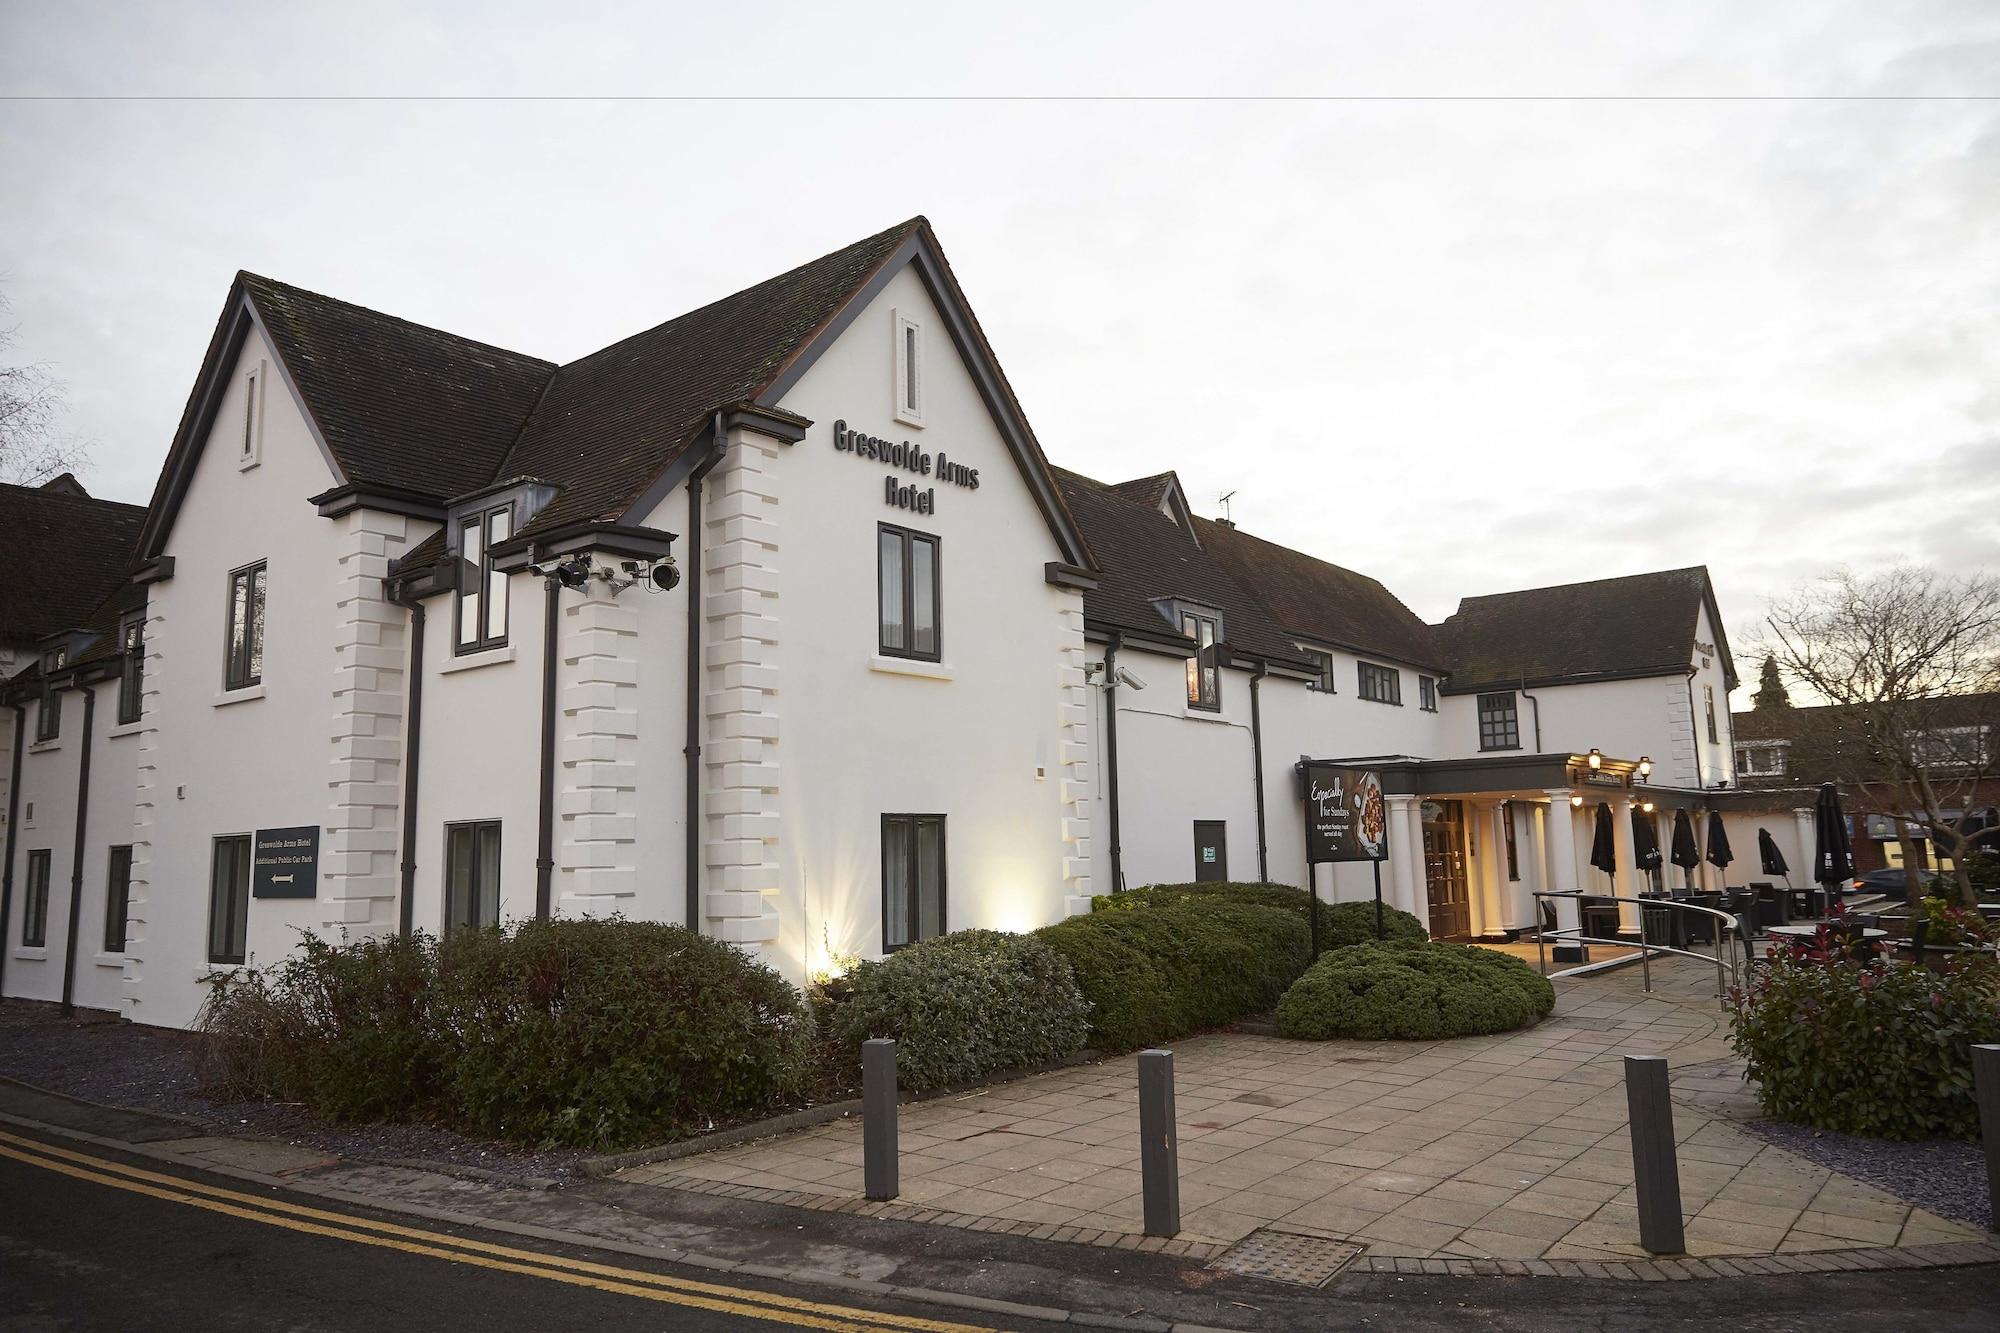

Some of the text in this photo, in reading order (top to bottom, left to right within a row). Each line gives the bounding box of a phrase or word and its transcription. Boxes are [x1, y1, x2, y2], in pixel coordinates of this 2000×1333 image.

[834, 419, 980, 490] Greswolde Arms
[885, 475, 934, 515] Hotel
[1311, 777, 1344, 817] Especially
[1331, 806, 1350, 819] Sundays
[297, 839, 311, 847] Hotel
[278, 856, 292, 864] Public
